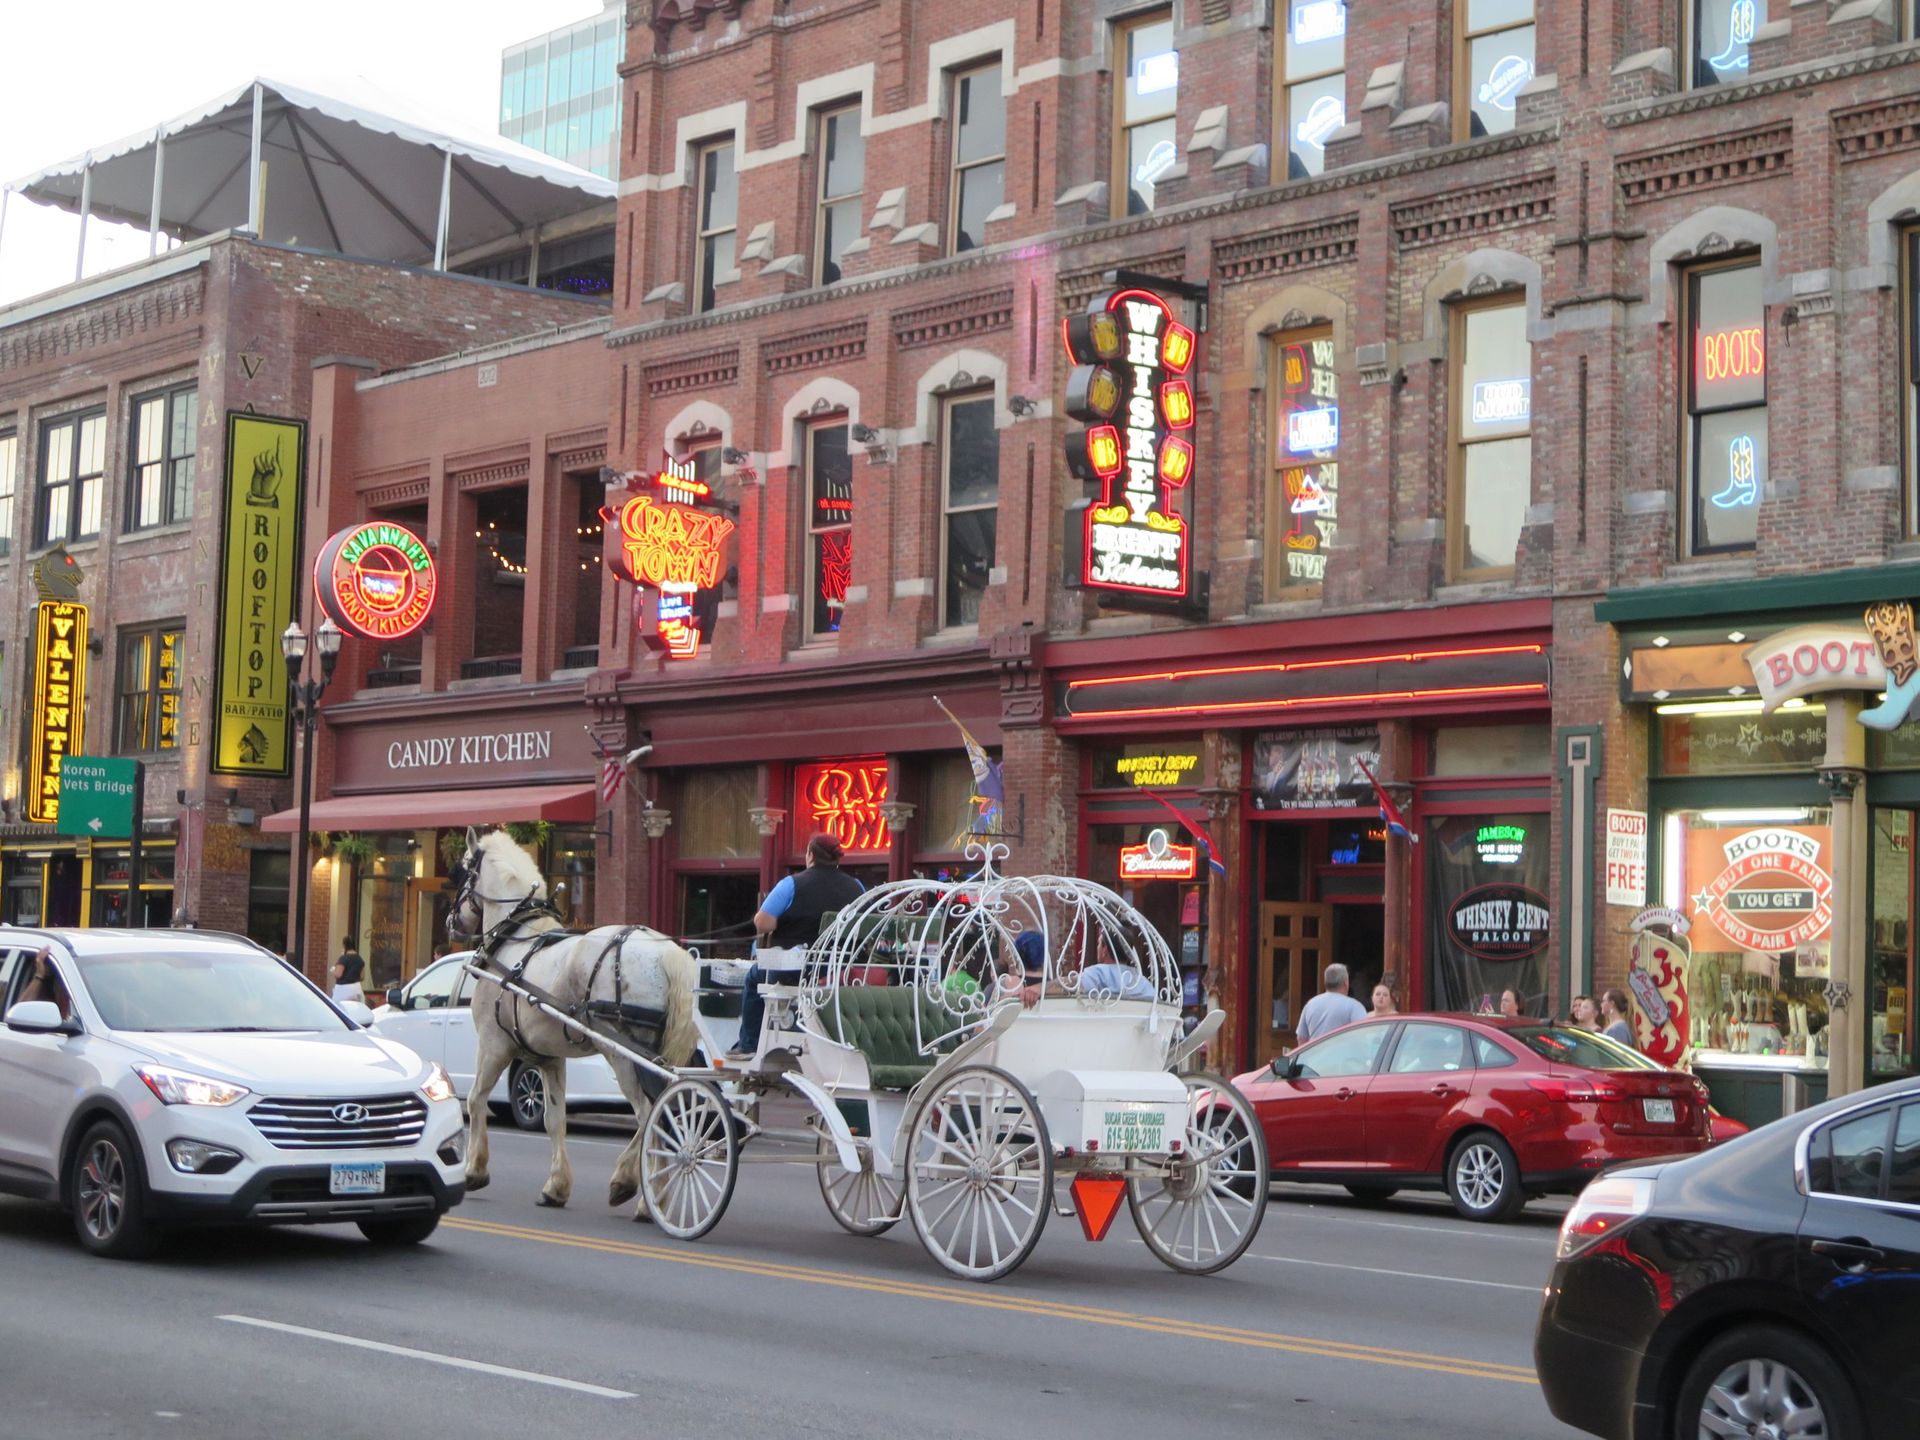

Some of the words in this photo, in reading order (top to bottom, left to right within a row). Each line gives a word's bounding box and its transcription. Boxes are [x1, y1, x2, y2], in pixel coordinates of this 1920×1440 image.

[1705, 328, 1763, 380] BOOTS
[1125, 300, 1162, 523] WHISKEY
[1095, 438, 1117, 467] WB
[621, 496, 735, 550] CRAZY
[341, 526, 429, 570] SAVANNAH'S
[1093, 524, 1181, 561] BENT
[624, 541, 720, 588] TOWN
[1092, 552, 1180, 588] Saloon
[54, 603, 73, 615] the
[247, 514, 270, 698] ROOFTOP
[339, 580, 377, 629] CANDY
[380, 587, 429, 633] KITCHEN
[661, 596, 683, 609] LIVE
[1766, 641, 1875, 688] BOOT
[43, 616, 74, 820] VALENTINE
[225, 703, 283, 718] BAR/PATIO
[388, 737, 456, 769] CANDY
[460, 731, 552, 764] KITCHEN
[1117, 756, 1166, 773] WHISKEY
[1166, 756, 1197, 770] BENT
[64, 764, 105, 777] Korean
[1134, 770, 1179, 785] SALOON
[64, 779, 89, 791] Vets
[95, 780, 133, 795] Bridge
[1477, 826, 1526, 842] JAMESON
[1612, 815, 1645, 835] BOOTS
[1478, 844, 1495, 853] LIVE
[1498, 844, 1522, 854] MUSIC
[1608, 848, 1619, 858] GET
[1620, 848, 1633, 859] TWO
[1612, 837, 1624, 848] BUY
[1728, 833, 1815, 861] BOOTS
[1717, 865, 1745, 891] BUY
[1751, 855, 1783, 868] ONE
[1789, 858, 1824, 889] PAIR
[1737, 893, 1769, 907] YOU
[1773, 893, 1802, 907] GET
[1456, 900, 1511, 930] WHISKEY
[1516, 901, 1549, 930] BENT
[1717, 912, 1747, 942] TWO
[1752, 934, 1786, 948] PAIR
[1790, 907, 1827, 943] FREE
[1472, 932, 1531, 942] SALOON
